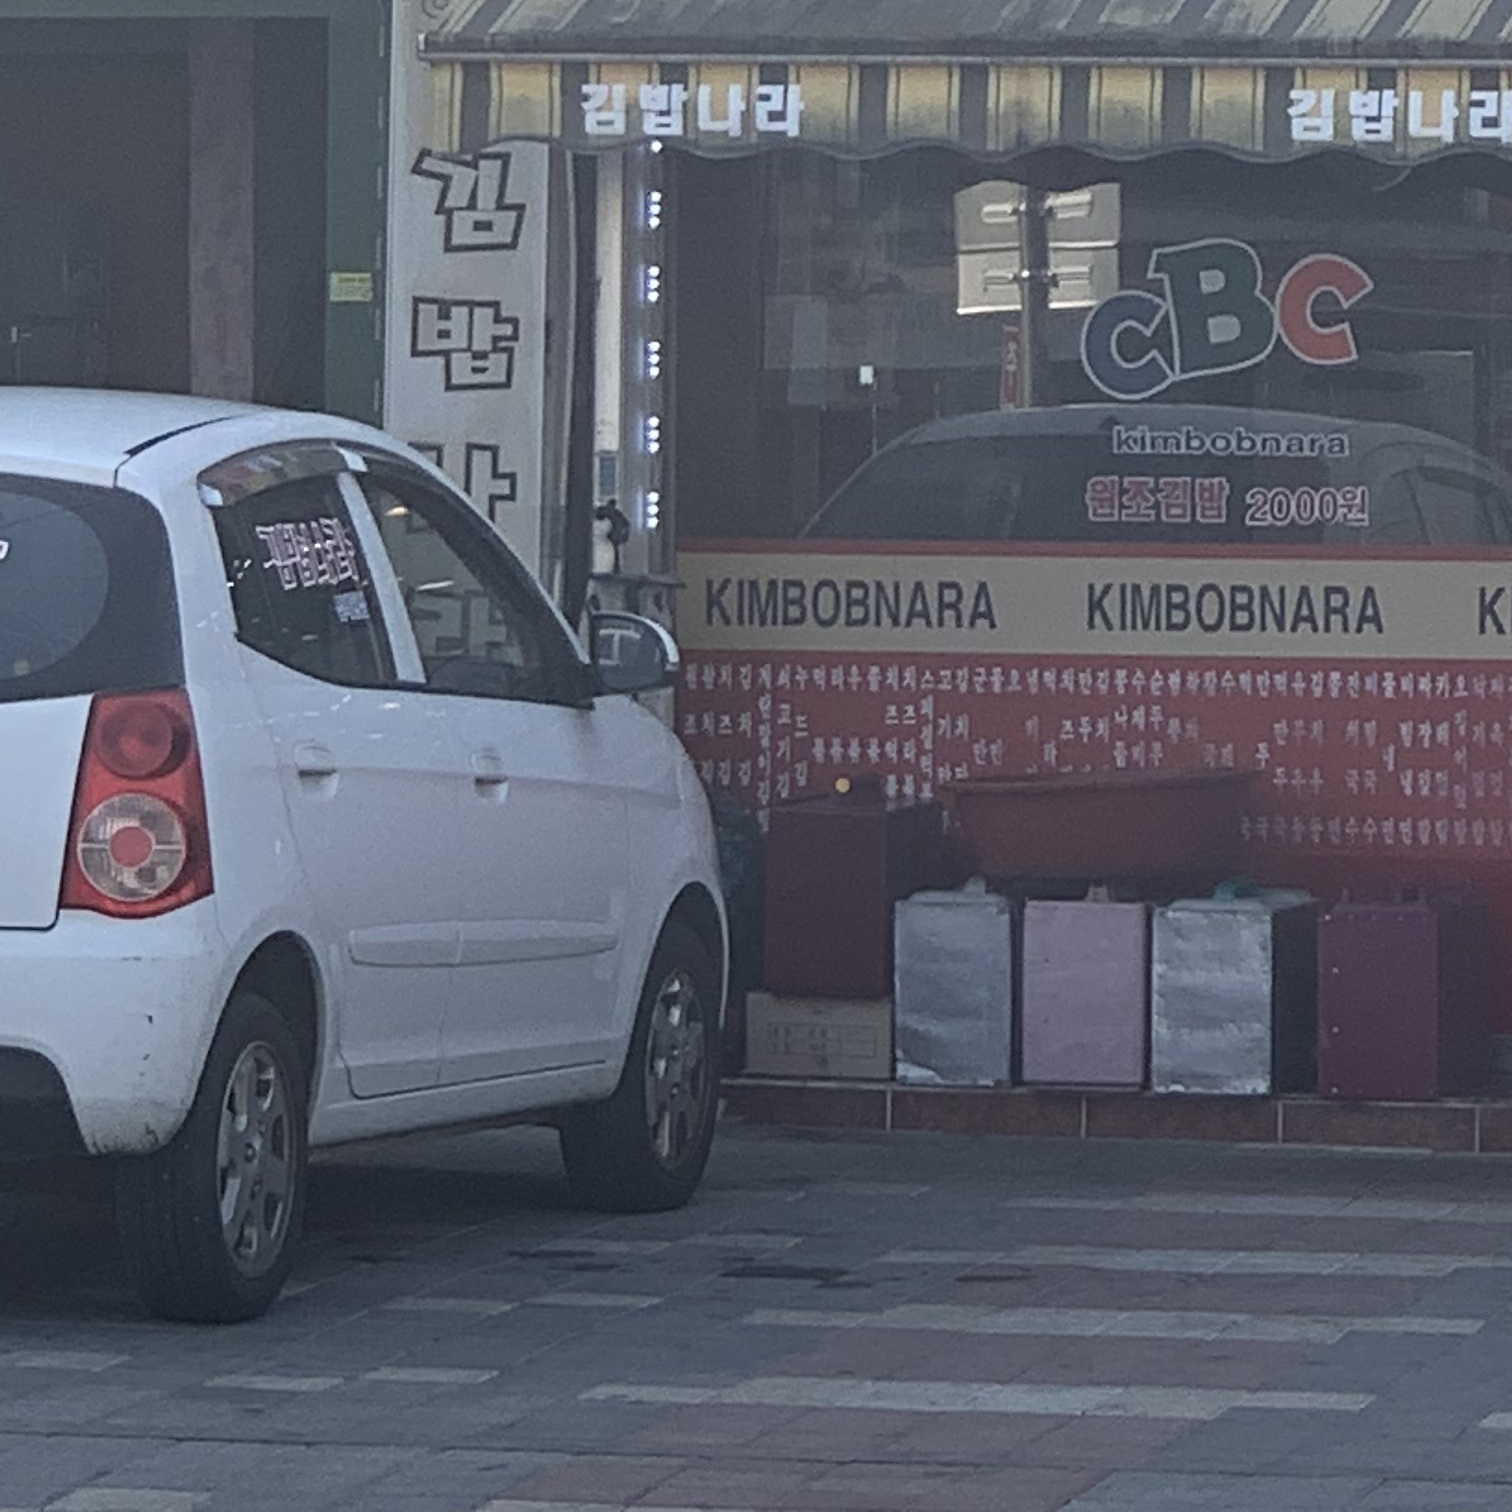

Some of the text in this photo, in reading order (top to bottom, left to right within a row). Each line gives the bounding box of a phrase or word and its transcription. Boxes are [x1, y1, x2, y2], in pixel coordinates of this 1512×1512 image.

[580, 83, 805, 138] 김밥나라
[1080, 237, 1375, 401] CBC
[1112, 425, 1351, 457] kimbobnara
[1085, 474, 1370, 528] 원조김밥 2000원
[704, 577, 998, 630] KIMBOBNARA
[1086, 581, 1384, 635] KIMBOBNARA
